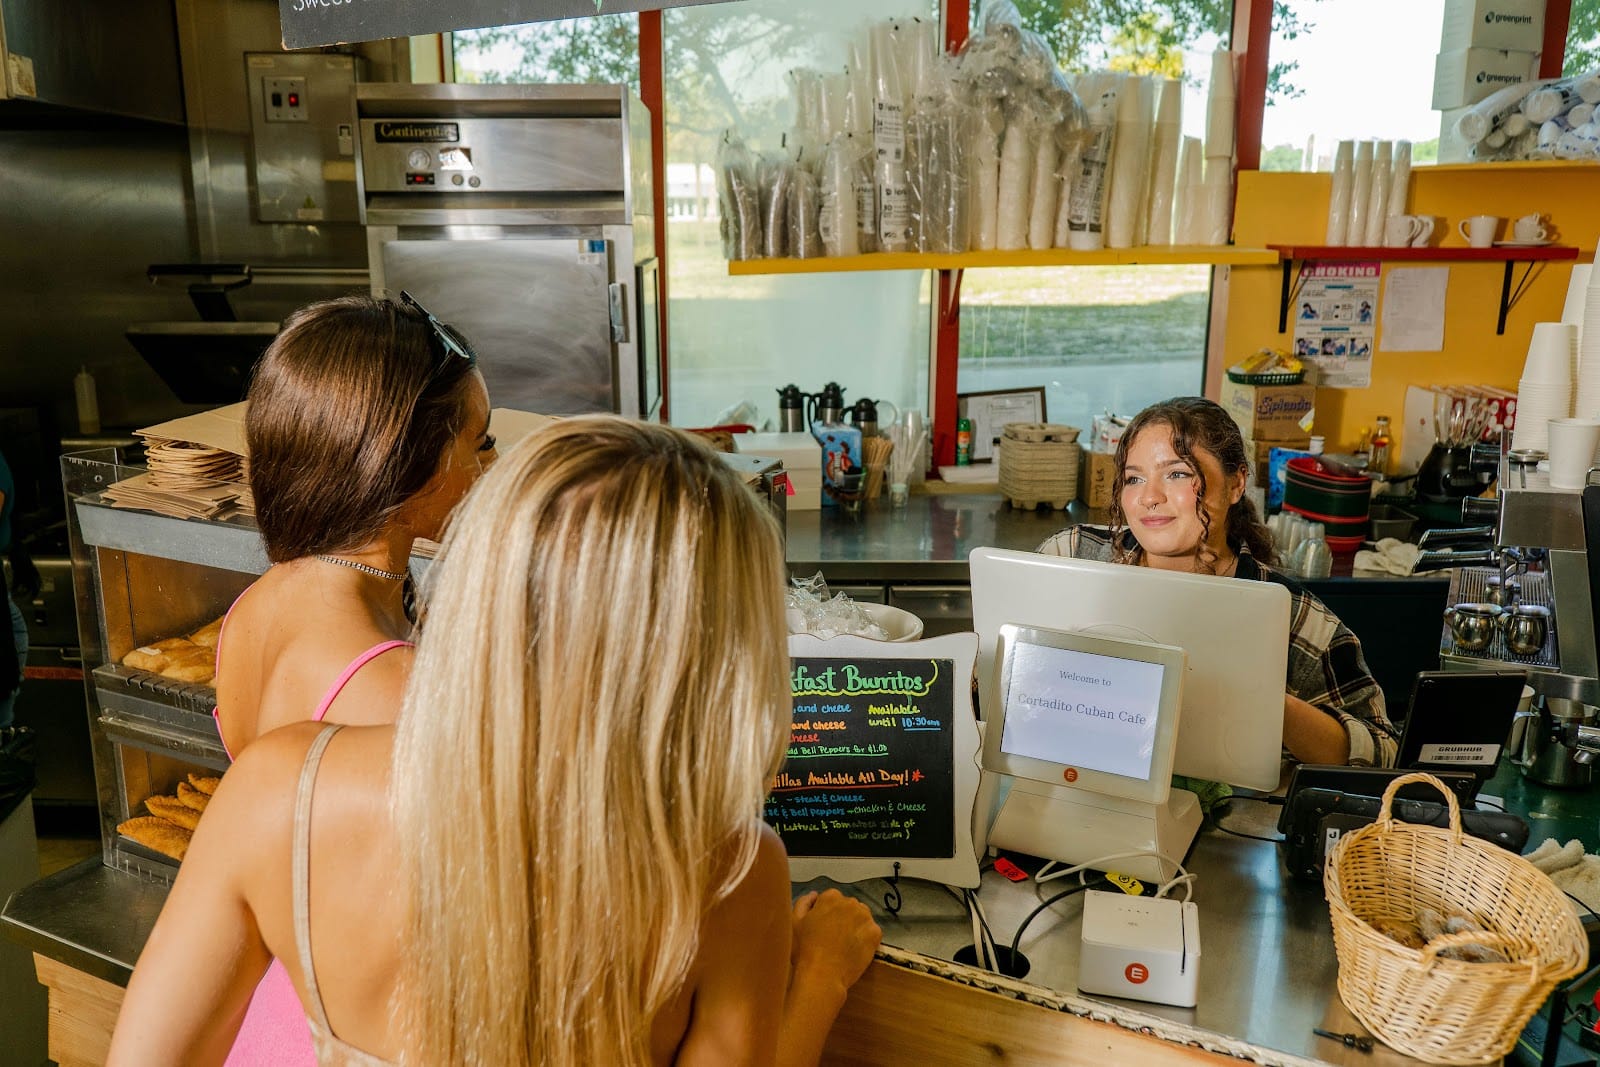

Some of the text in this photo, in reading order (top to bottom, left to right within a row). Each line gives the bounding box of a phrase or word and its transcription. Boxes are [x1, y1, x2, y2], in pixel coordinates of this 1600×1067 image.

[1496, 14, 1532, 24] greenprint
[1487, 73, 1522, 84] greenprint
[841, 664, 923, 692] Burritos
[1059, 670, 1112, 687] Welcome to
[821, 704, 852, 713] cheese
[868, 703, 920, 715] Available
[1018, 693, 1147, 725] Cortadito Cuban Cafe
[812, 720, 847, 731] cheese
[868, 717, 896, 727] until
[791, 733, 820, 743] heese
[800, 745, 817, 755] Bell
[807, 771, 856, 786] Available
[858, 771, 876, 783] All
[878, 768, 909, 786] Day!
